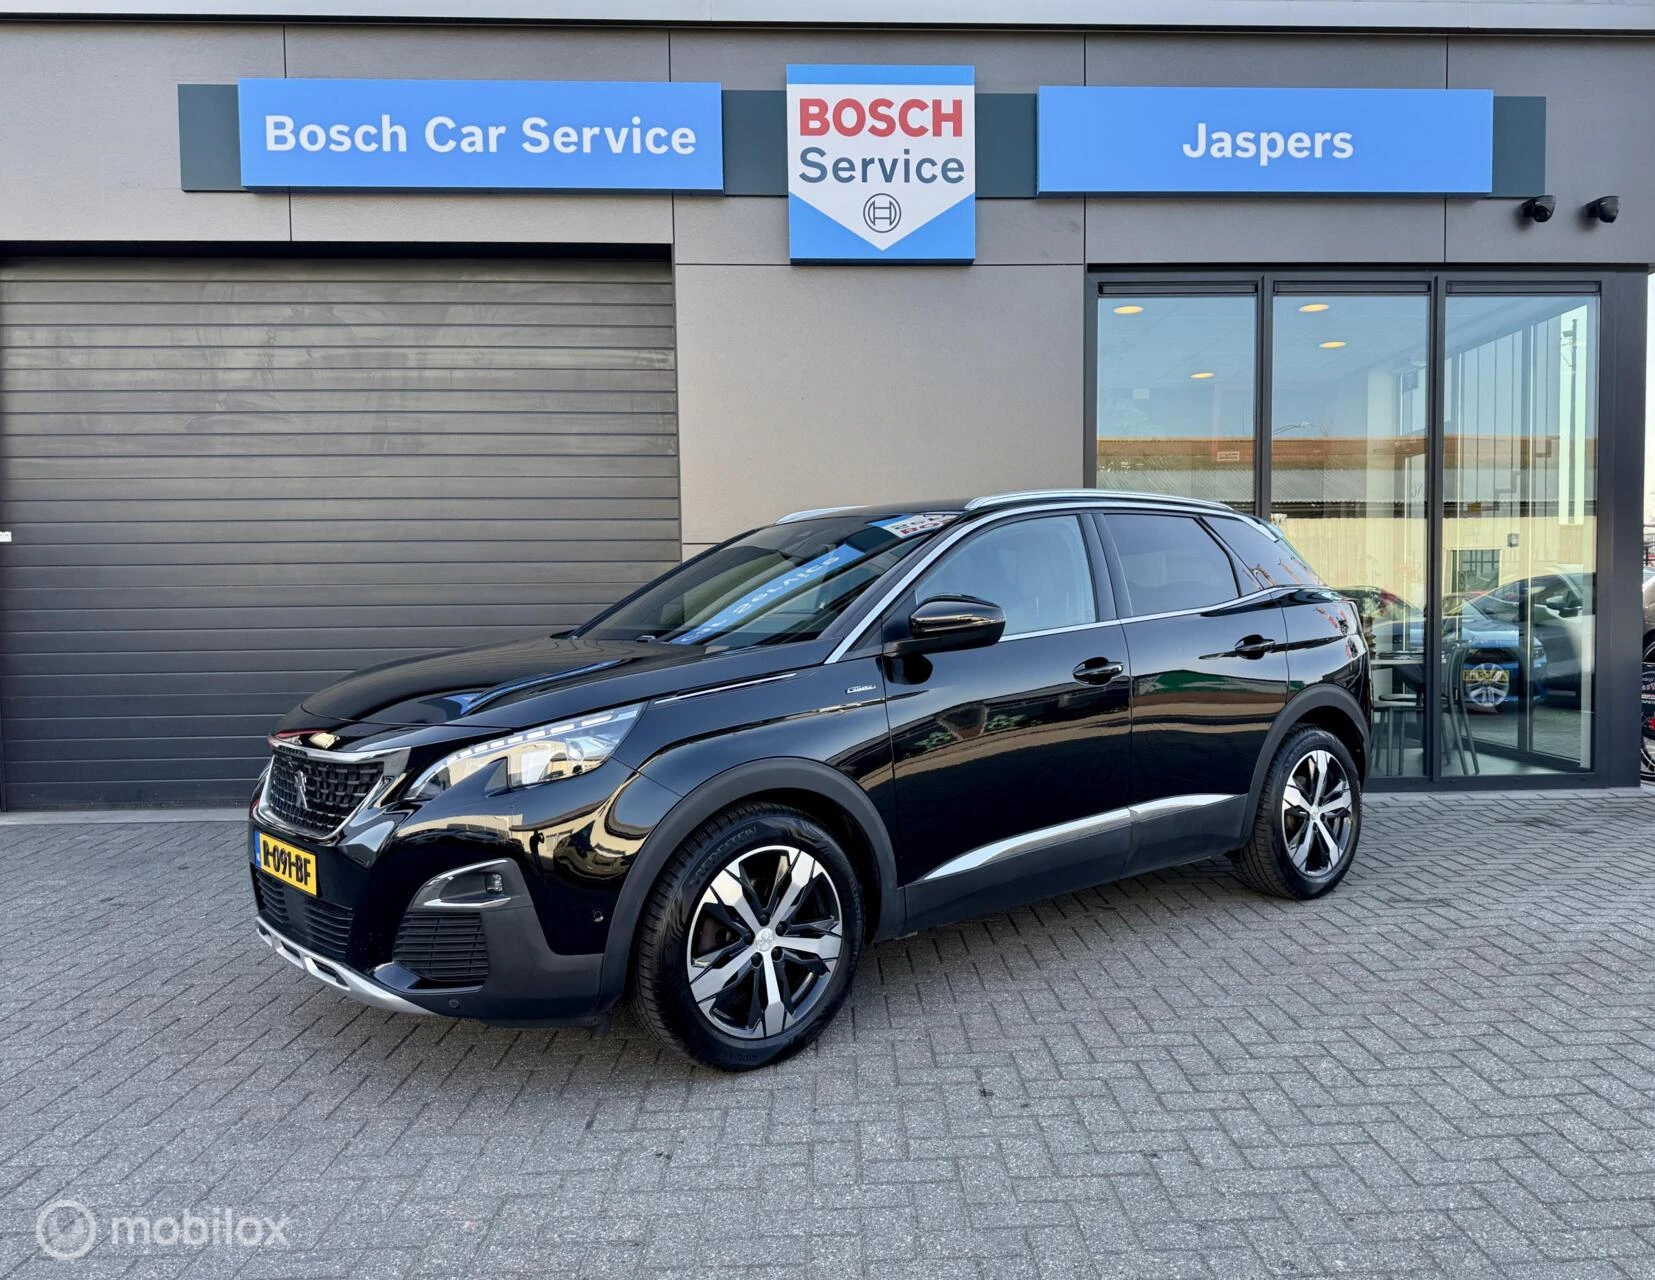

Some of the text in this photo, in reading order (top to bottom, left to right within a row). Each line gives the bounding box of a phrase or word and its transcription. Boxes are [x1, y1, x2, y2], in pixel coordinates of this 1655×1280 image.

[266, 114, 696, 155] Bosch Car Service
[800, 98, 963, 137] BOSCH
[1182, 123, 1354, 166] Jaspers
[799, 146, 965, 184] Service
